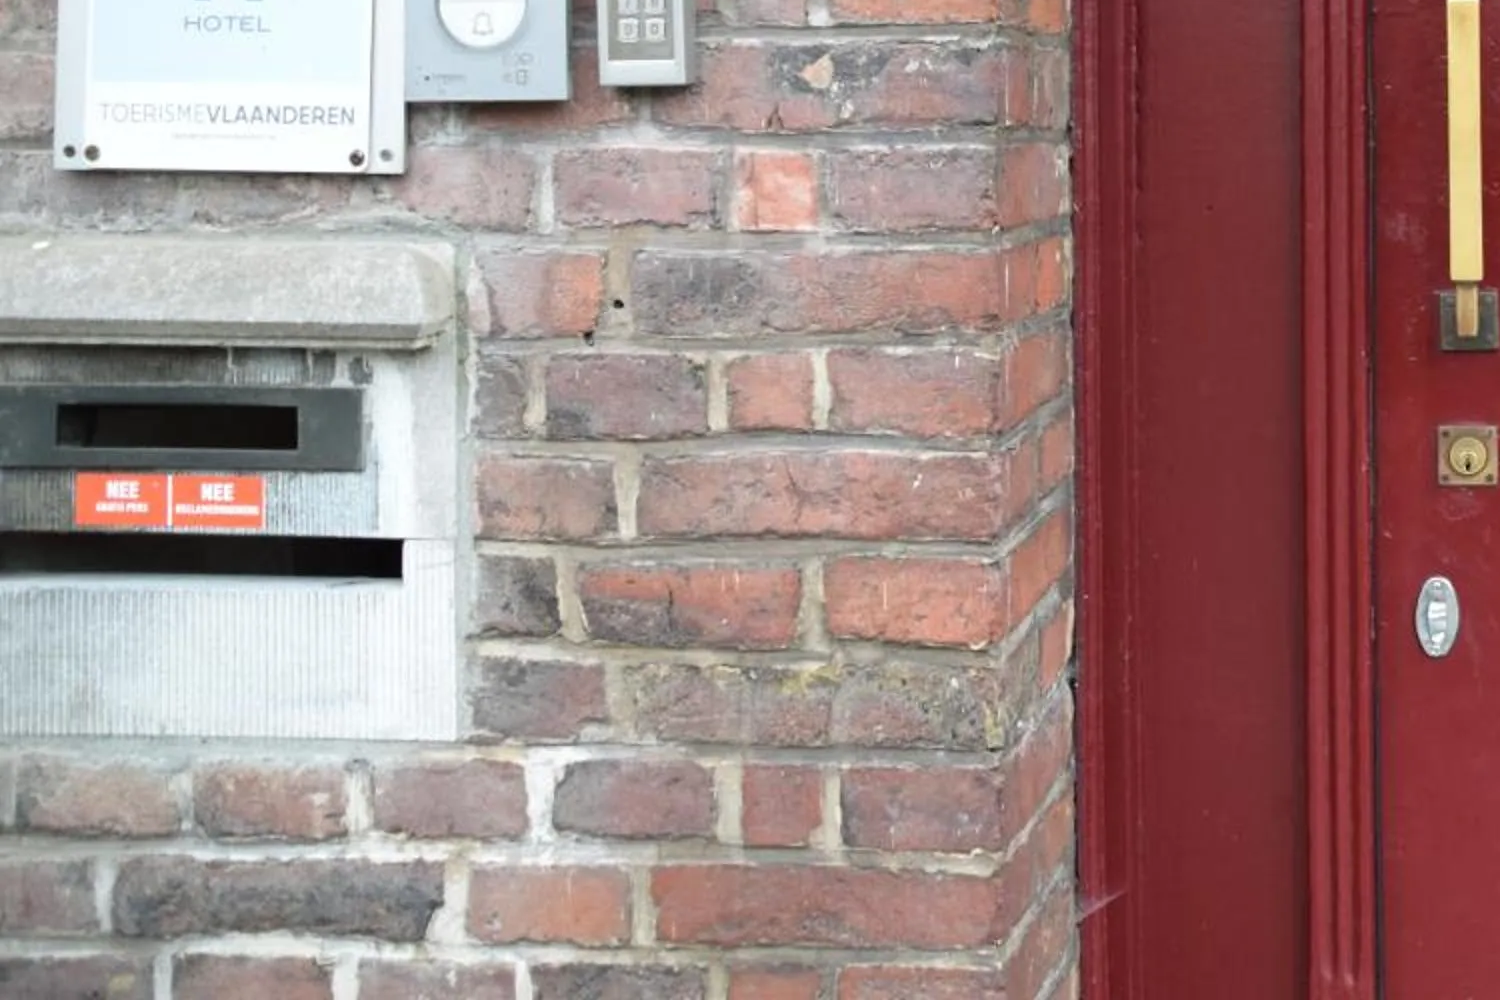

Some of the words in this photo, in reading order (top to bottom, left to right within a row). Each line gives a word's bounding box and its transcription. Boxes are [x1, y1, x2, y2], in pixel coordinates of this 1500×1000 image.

[183, 15, 272, 33] HOTEL
[106, 480, 140, 500] NEE
[201, 482, 234, 502] NEE
